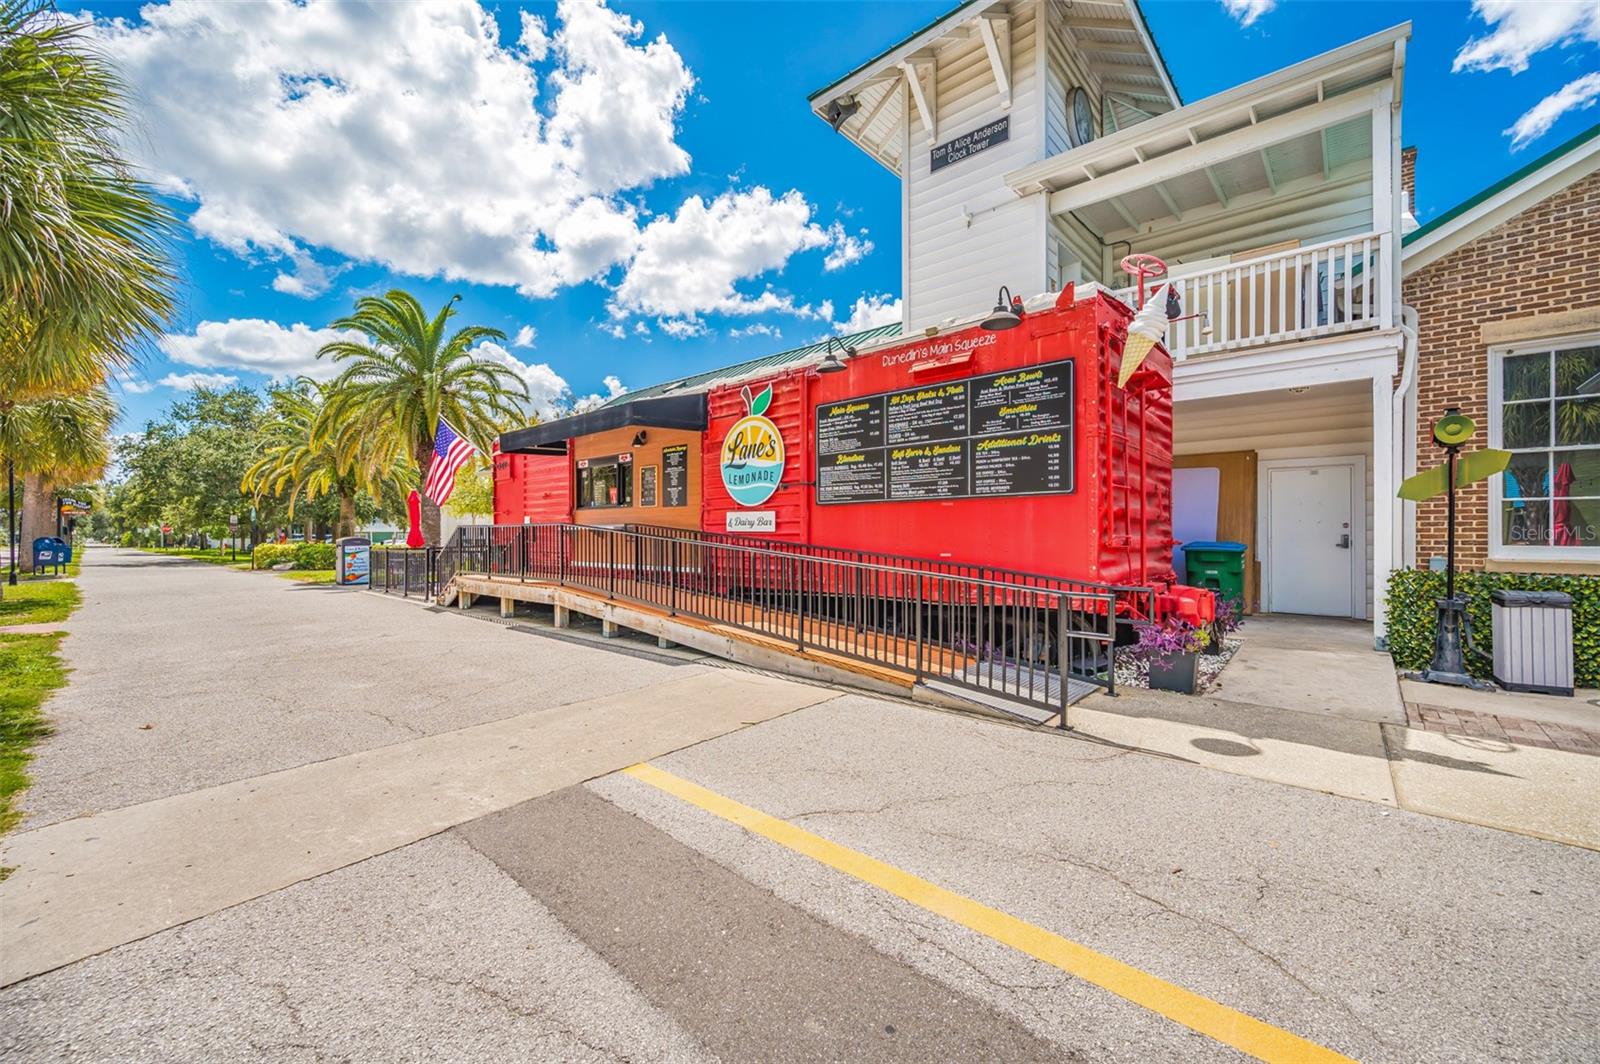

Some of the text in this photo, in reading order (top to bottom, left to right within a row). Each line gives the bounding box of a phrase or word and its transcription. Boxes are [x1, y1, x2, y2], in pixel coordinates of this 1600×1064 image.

[932, 120, 1007, 160] Tom & Alice Anderson
[948, 139, 989, 162] Clock Tower
[883, 334, 996, 367] Dunedin's Main Squeeze
[1017, 370, 1043, 382] Bowls
[999, 404, 1037, 416] Smoothies
[976, 433, 1061, 451] Additional Drinks
[725, 432, 775, 469] Lane's
[905, 448, 923, 458] Serve
[924, 446, 932, 455] &
[729, 470, 774, 485] LEMONADE
[734, 517, 755, 528] Dairy
[757, 516, 772, 526] Bar
